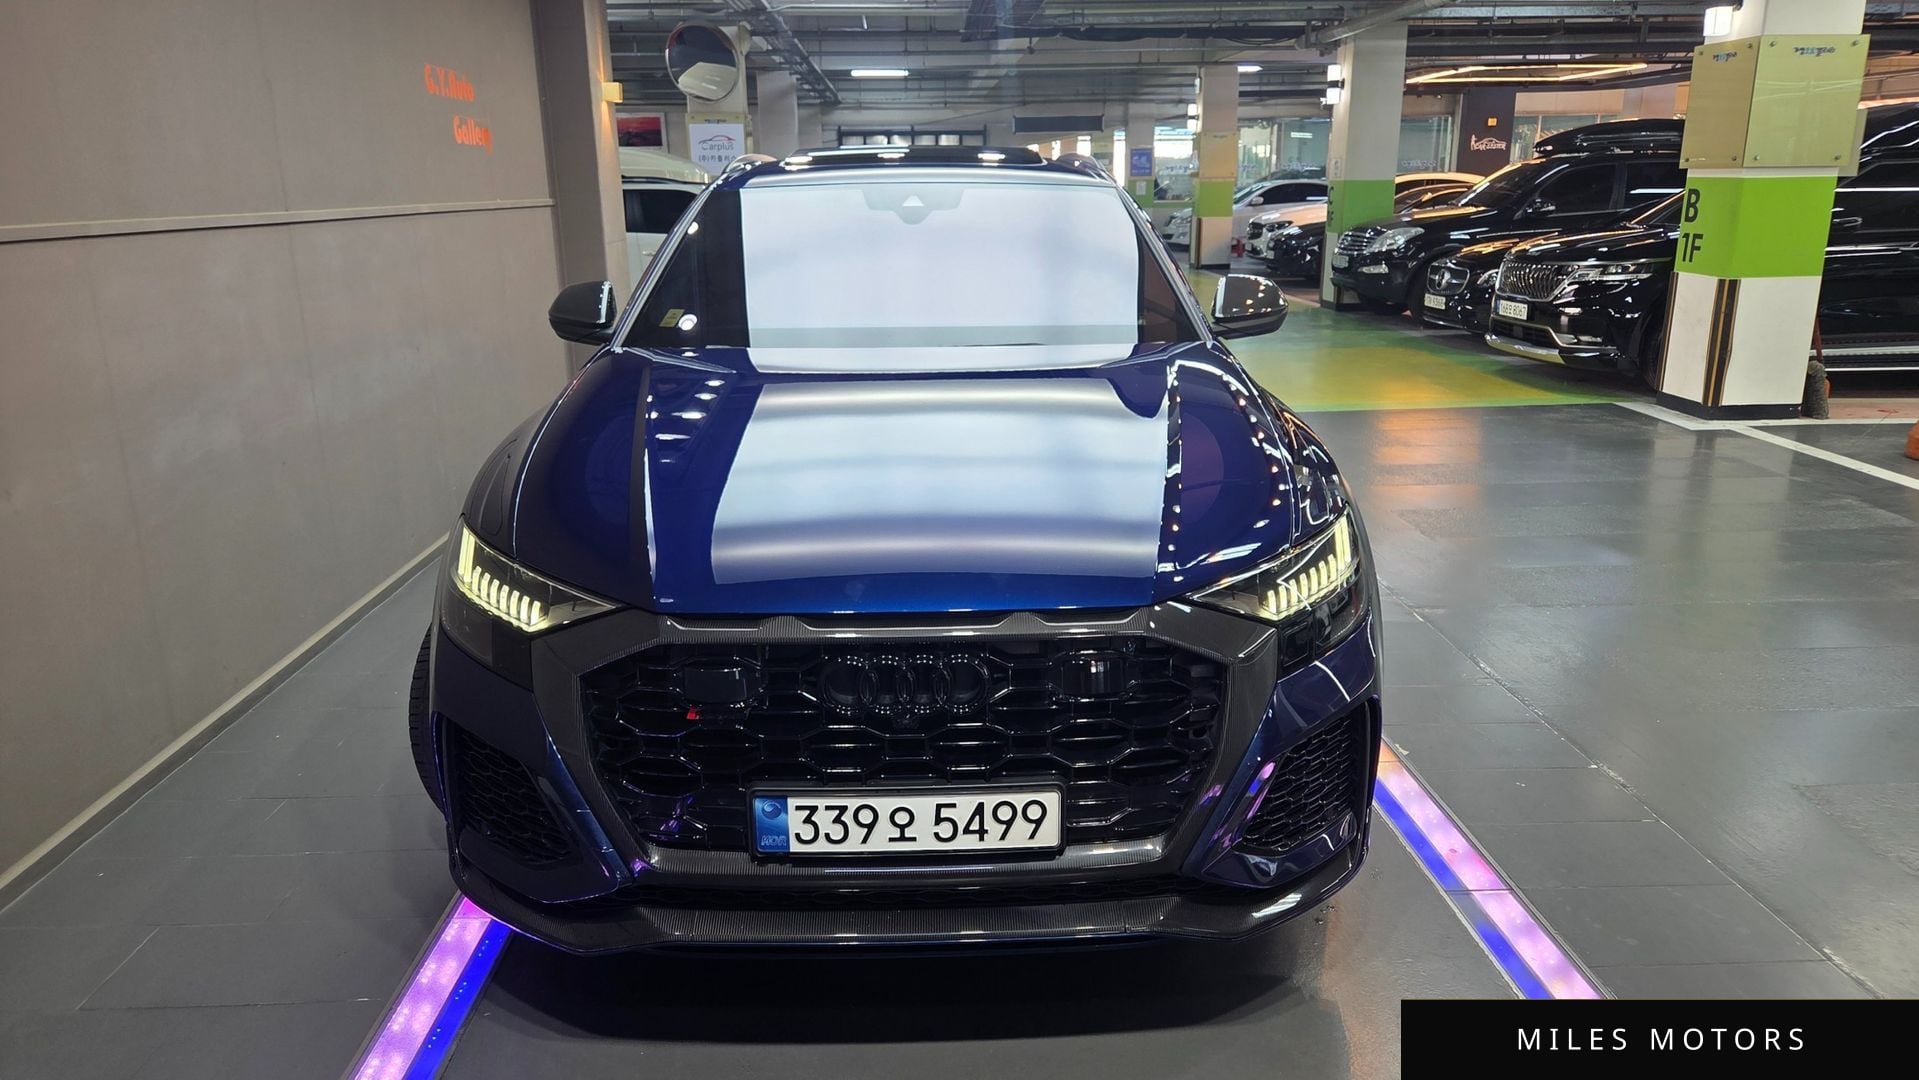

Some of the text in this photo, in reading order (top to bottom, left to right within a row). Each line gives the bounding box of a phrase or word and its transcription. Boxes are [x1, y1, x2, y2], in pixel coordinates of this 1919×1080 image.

[1684, 188, 1701, 223] B
[1682, 232, 1704, 263] 1F
[794, 799, 1048, 845] 339오 5499
